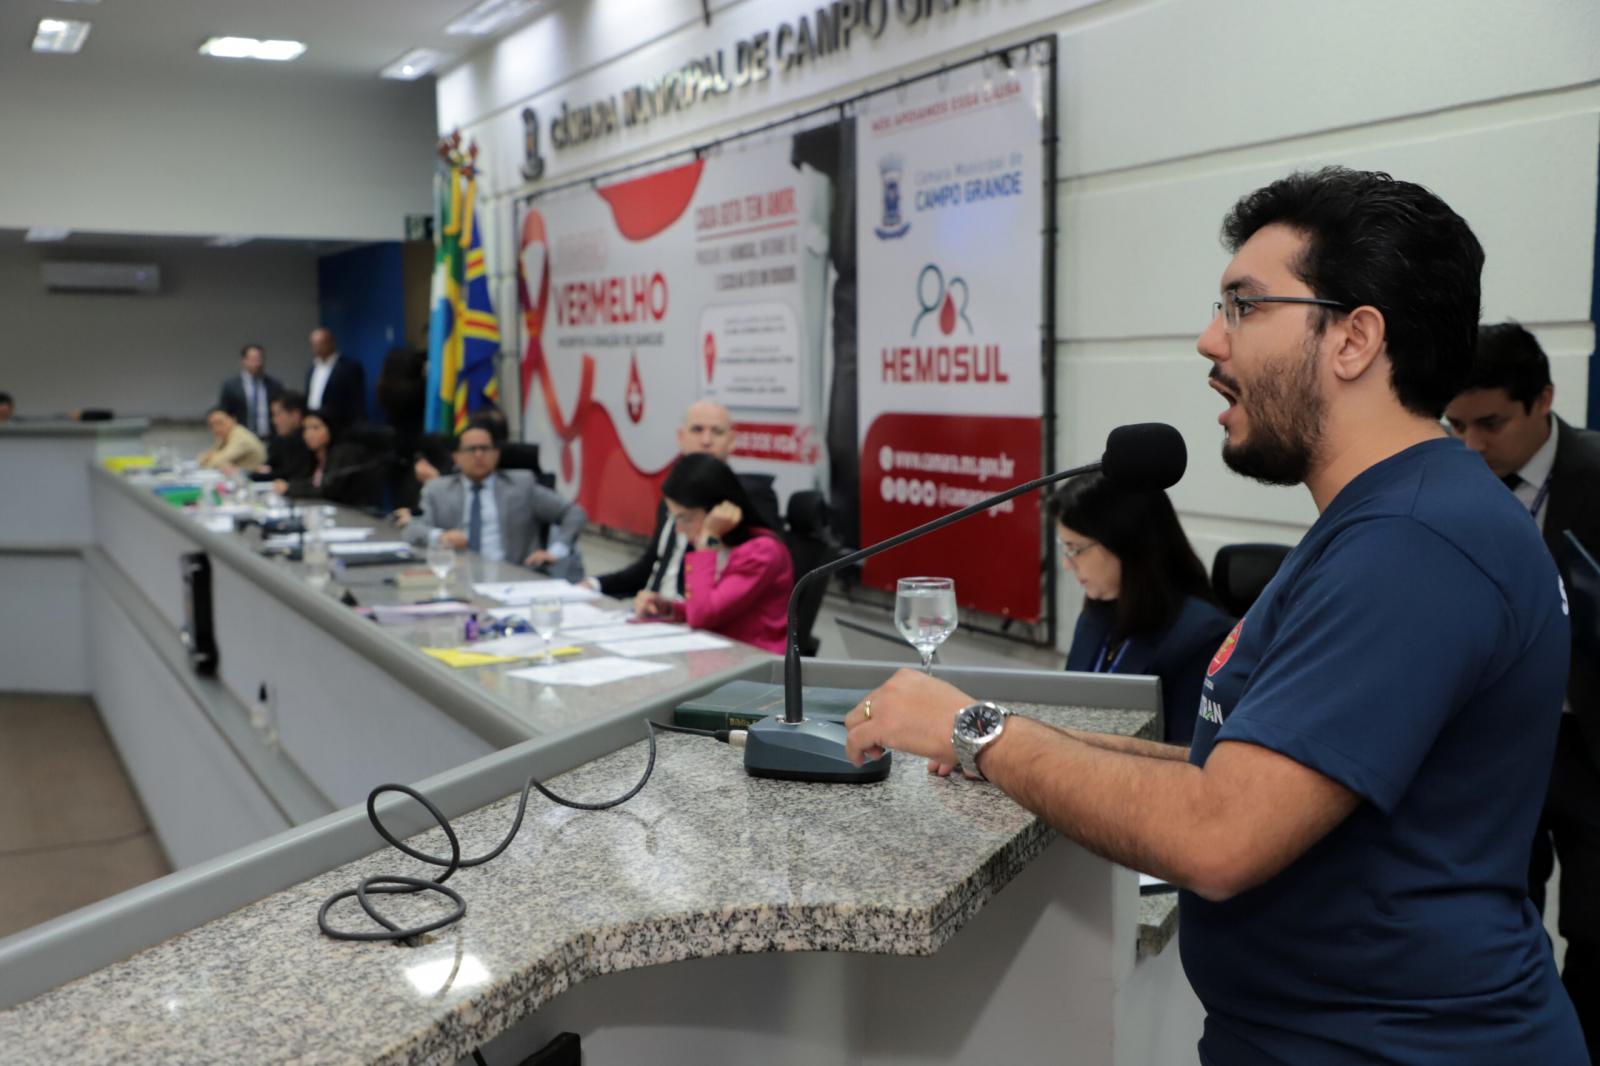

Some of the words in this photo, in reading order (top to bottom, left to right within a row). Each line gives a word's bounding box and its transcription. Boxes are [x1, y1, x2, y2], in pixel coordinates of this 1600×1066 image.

[735, 33, 771, 88] DE
[776, 0, 888, 71] CAMPO
[915, 183, 960, 212] CAMPO
[963, 171, 1023, 203] GRANDE
[553, 271, 669, 327] VERMELHO
[881, 345, 1009, 383] HEMOSUL
